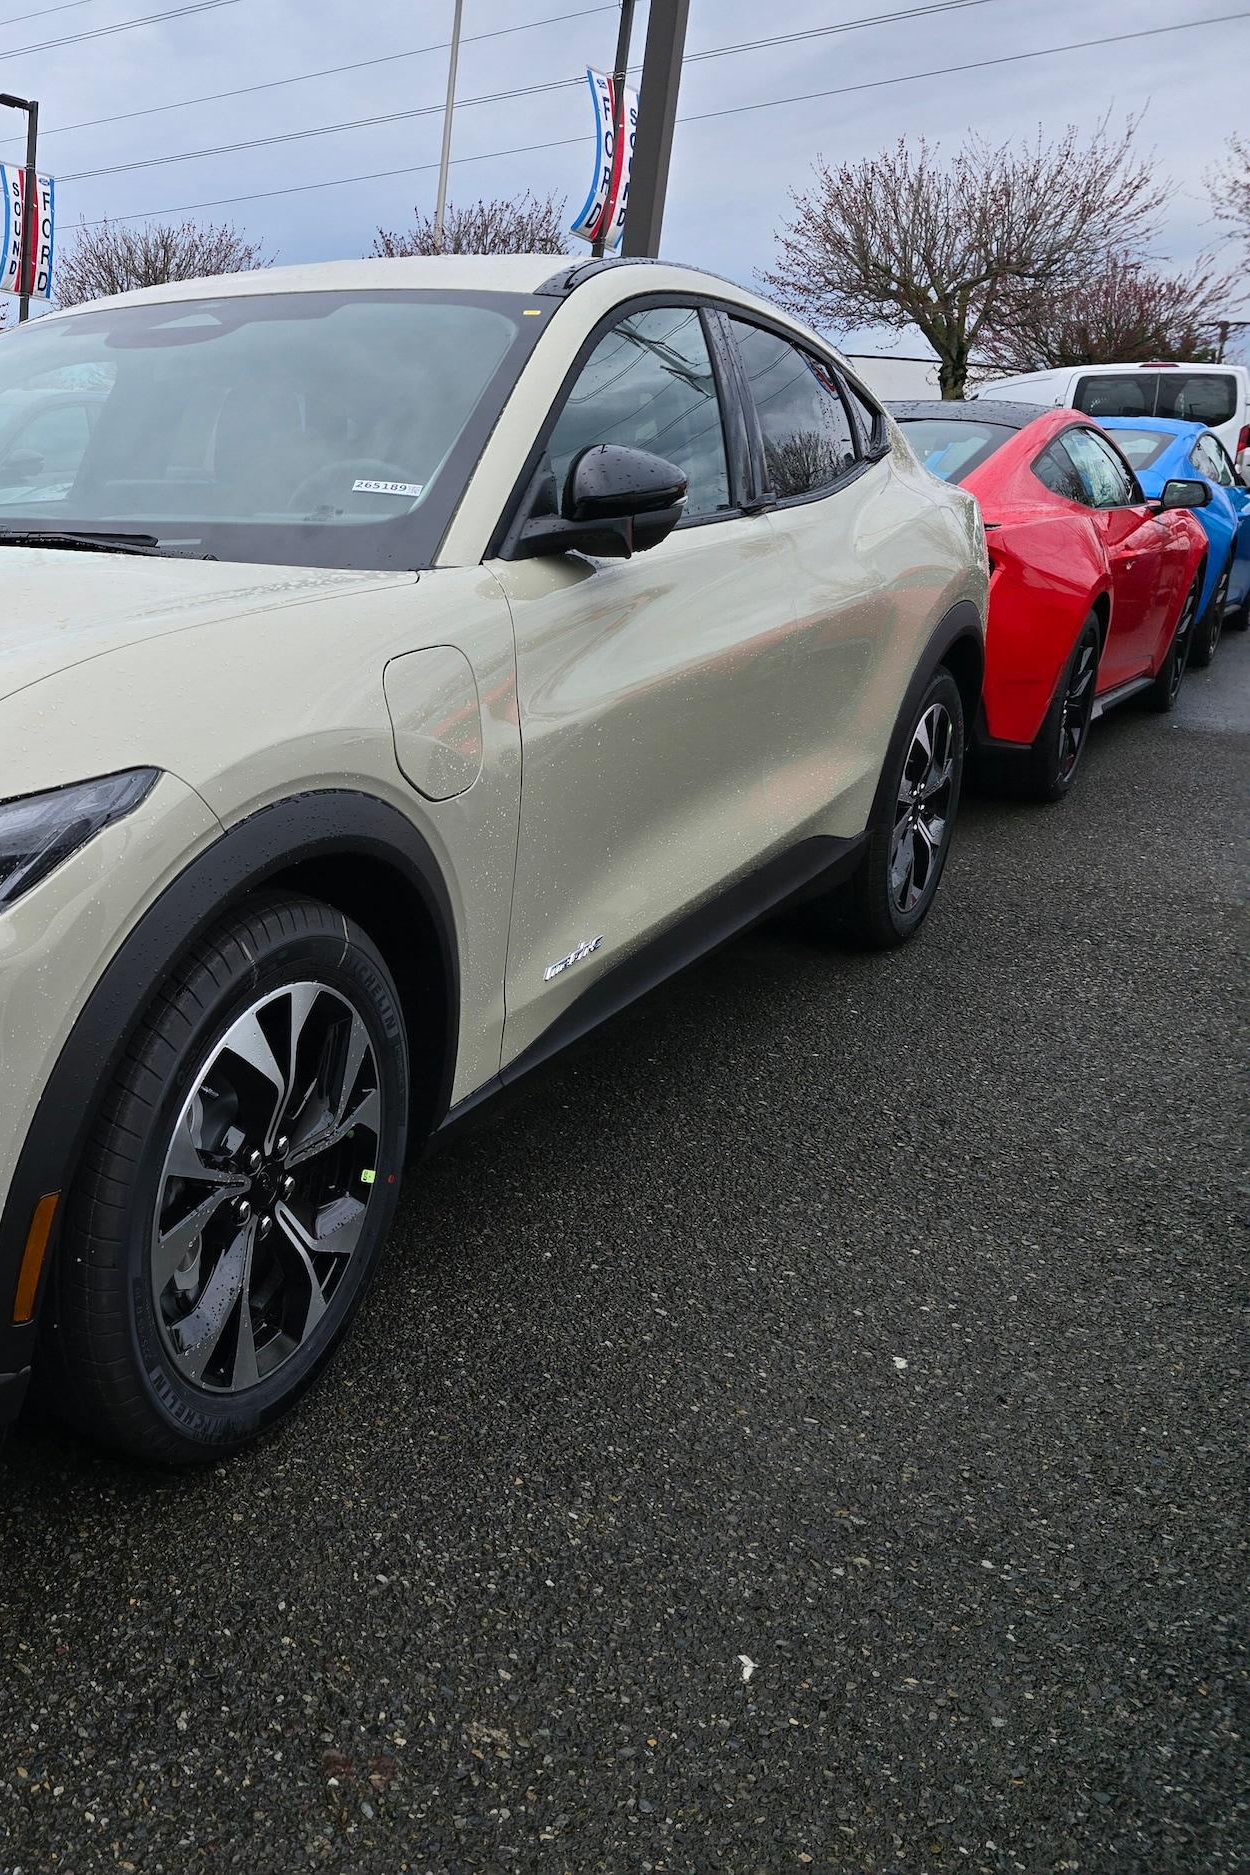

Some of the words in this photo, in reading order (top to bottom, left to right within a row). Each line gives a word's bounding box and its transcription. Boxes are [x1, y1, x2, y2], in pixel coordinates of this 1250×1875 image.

[585, 97, 613, 228] FORD
[9, 182, 21, 274] SOUND
[37, 191, 51, 291] FORD
[355, 481, 407, 491] 265189
[153, 1373, 225, 1434] MICHELIN
